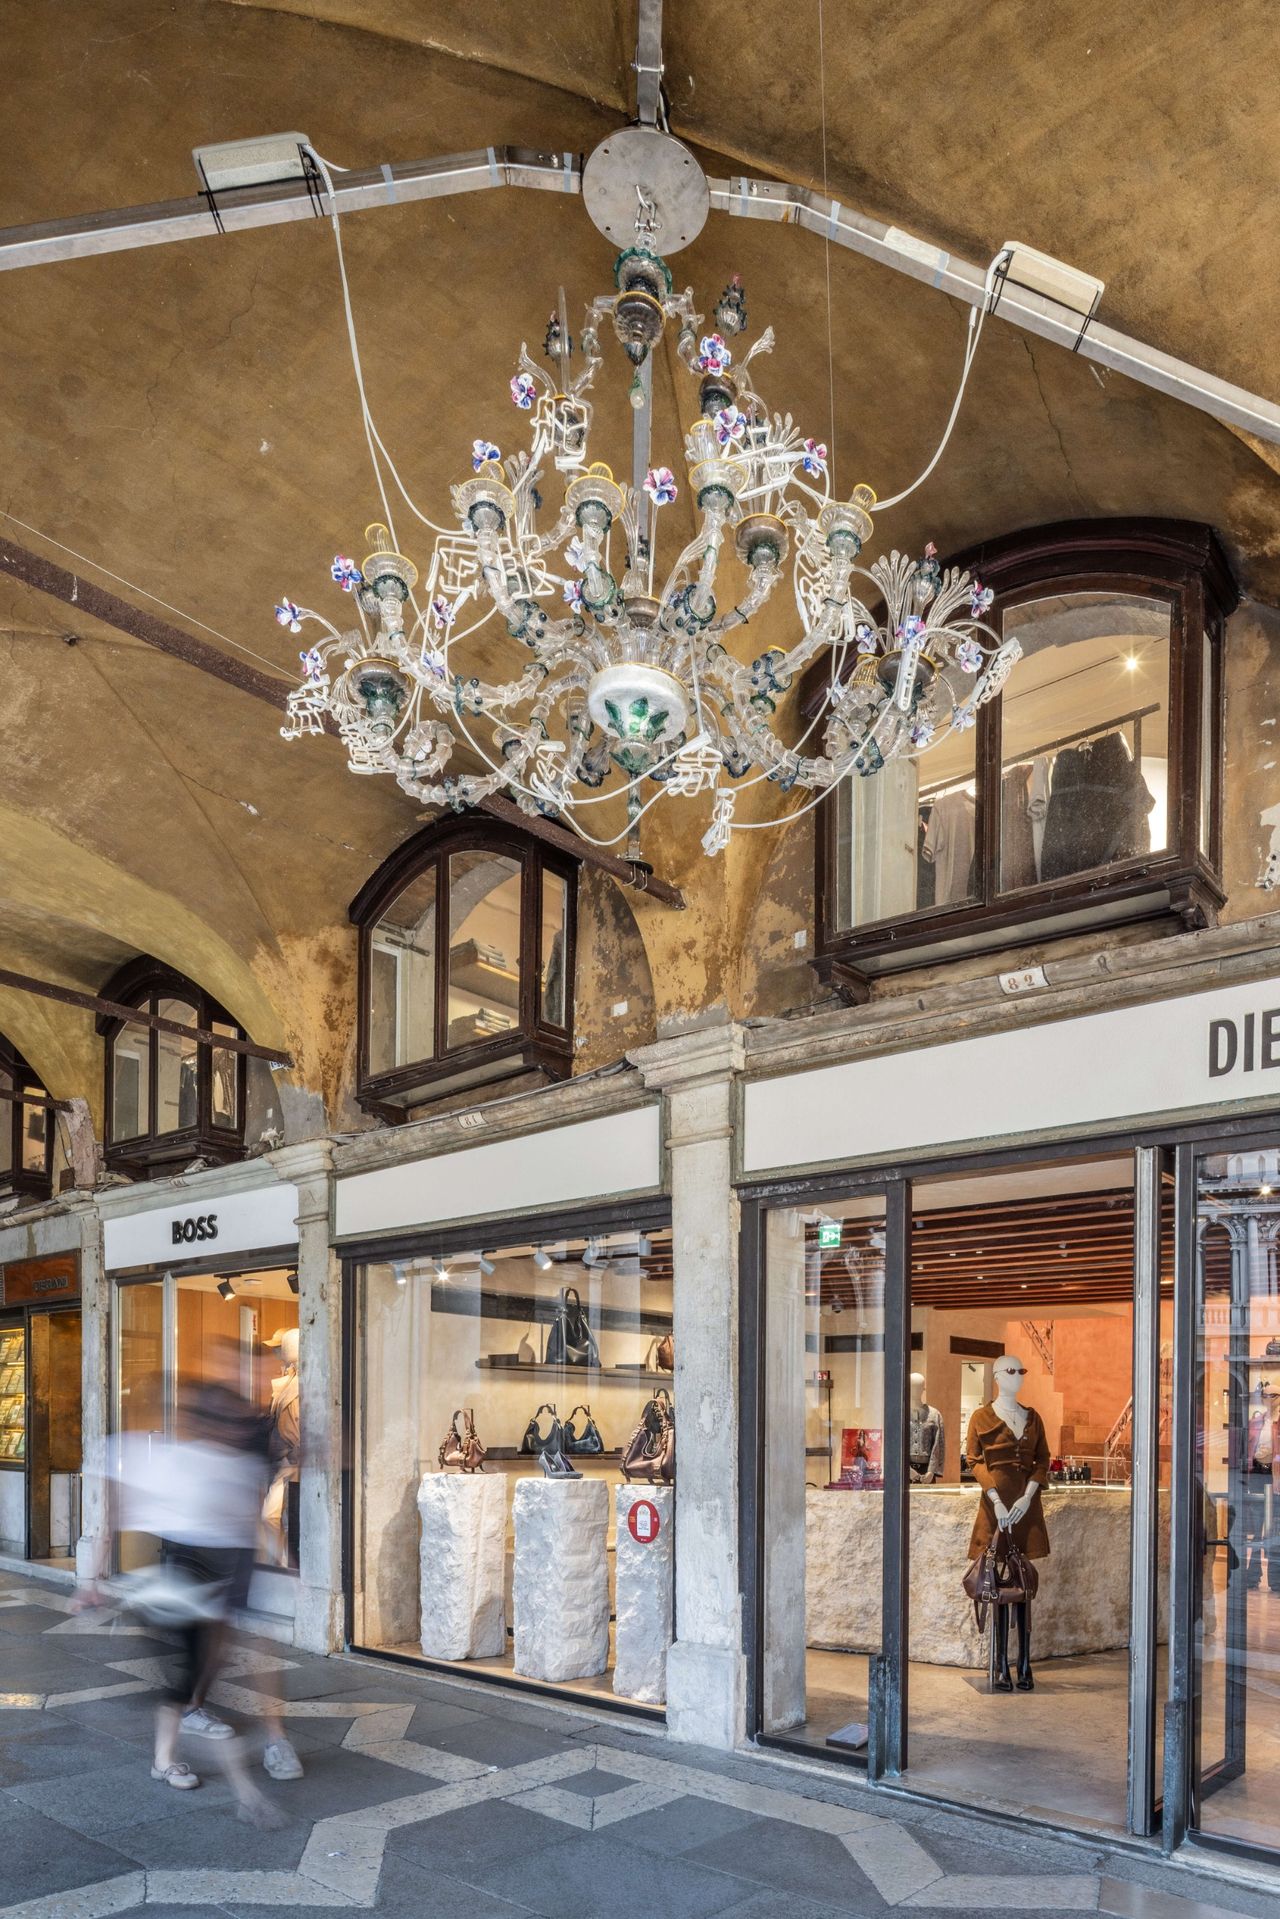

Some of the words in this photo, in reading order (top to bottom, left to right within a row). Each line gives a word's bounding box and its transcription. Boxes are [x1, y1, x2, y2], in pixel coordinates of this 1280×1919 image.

[1007, 974, 1035, 990] 82
[1208, 1007, 1280, 1078] DIE
[171, 1213, 219, 1245] BOSS
